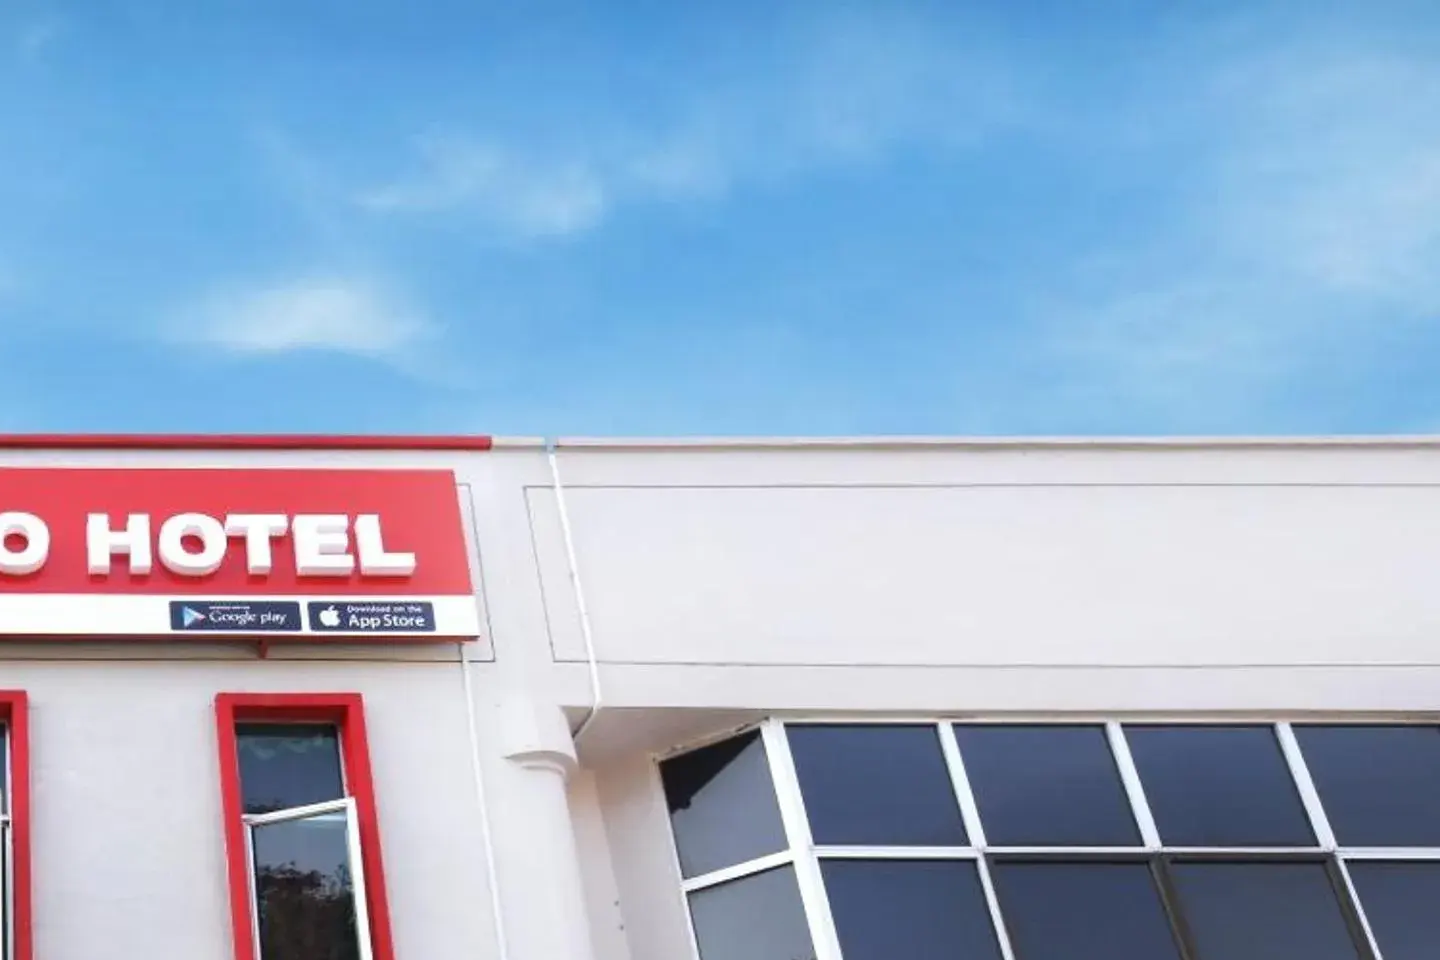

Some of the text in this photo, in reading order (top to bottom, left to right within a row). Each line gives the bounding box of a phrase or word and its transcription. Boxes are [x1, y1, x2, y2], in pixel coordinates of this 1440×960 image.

[86, 512, 416, 577] HOTEL
[209, 610, 287, 625] Google play
[349, 614, 425, 629] App Store
